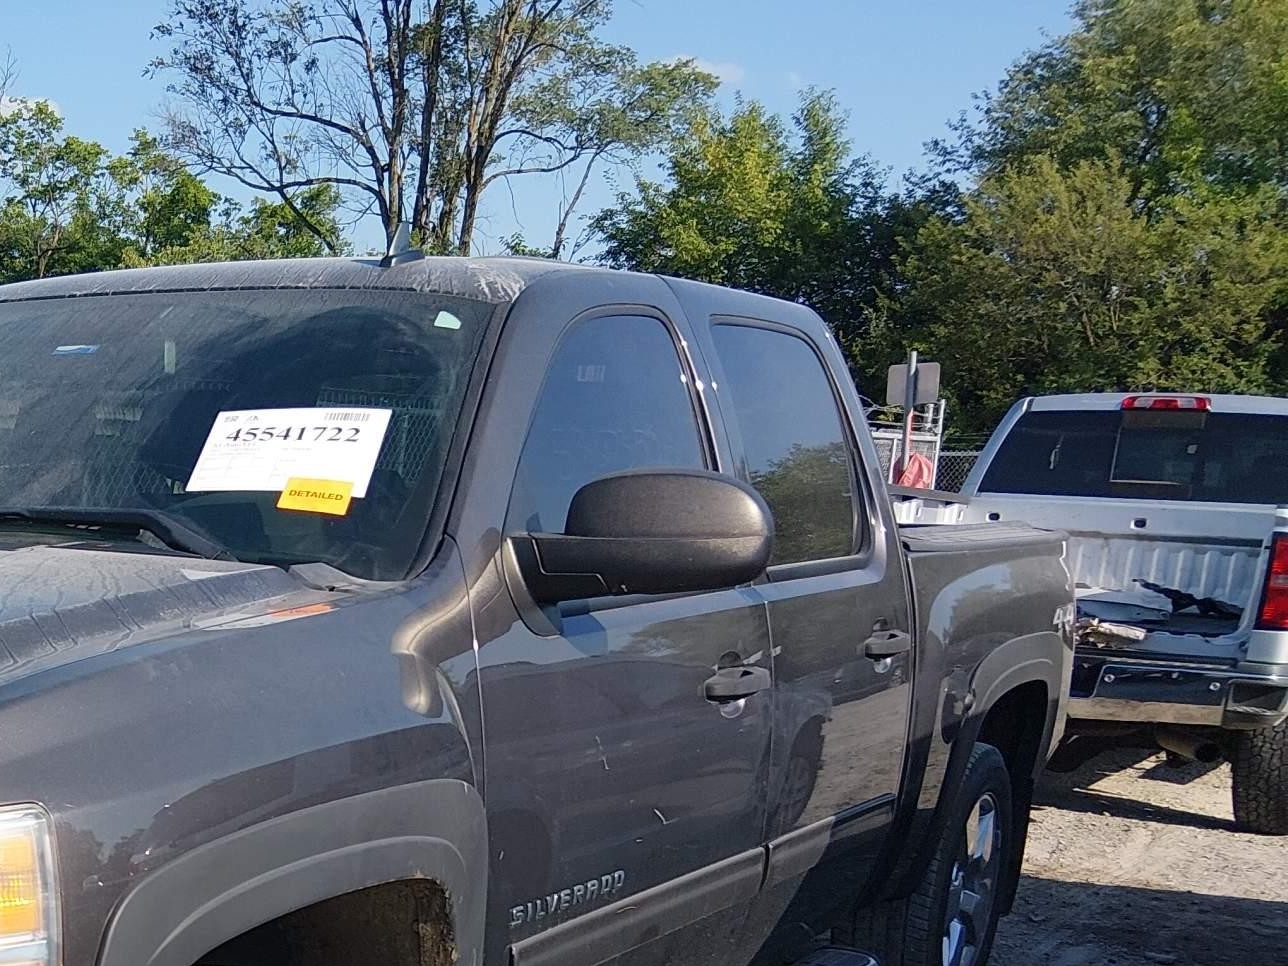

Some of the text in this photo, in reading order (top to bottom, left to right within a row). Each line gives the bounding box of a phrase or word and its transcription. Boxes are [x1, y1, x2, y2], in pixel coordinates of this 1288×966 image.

[225, 426, 361, 442] 45541722
[288, 489, 344, 501] DETAILED
[509, 869, 625, 926] SILVERADO
